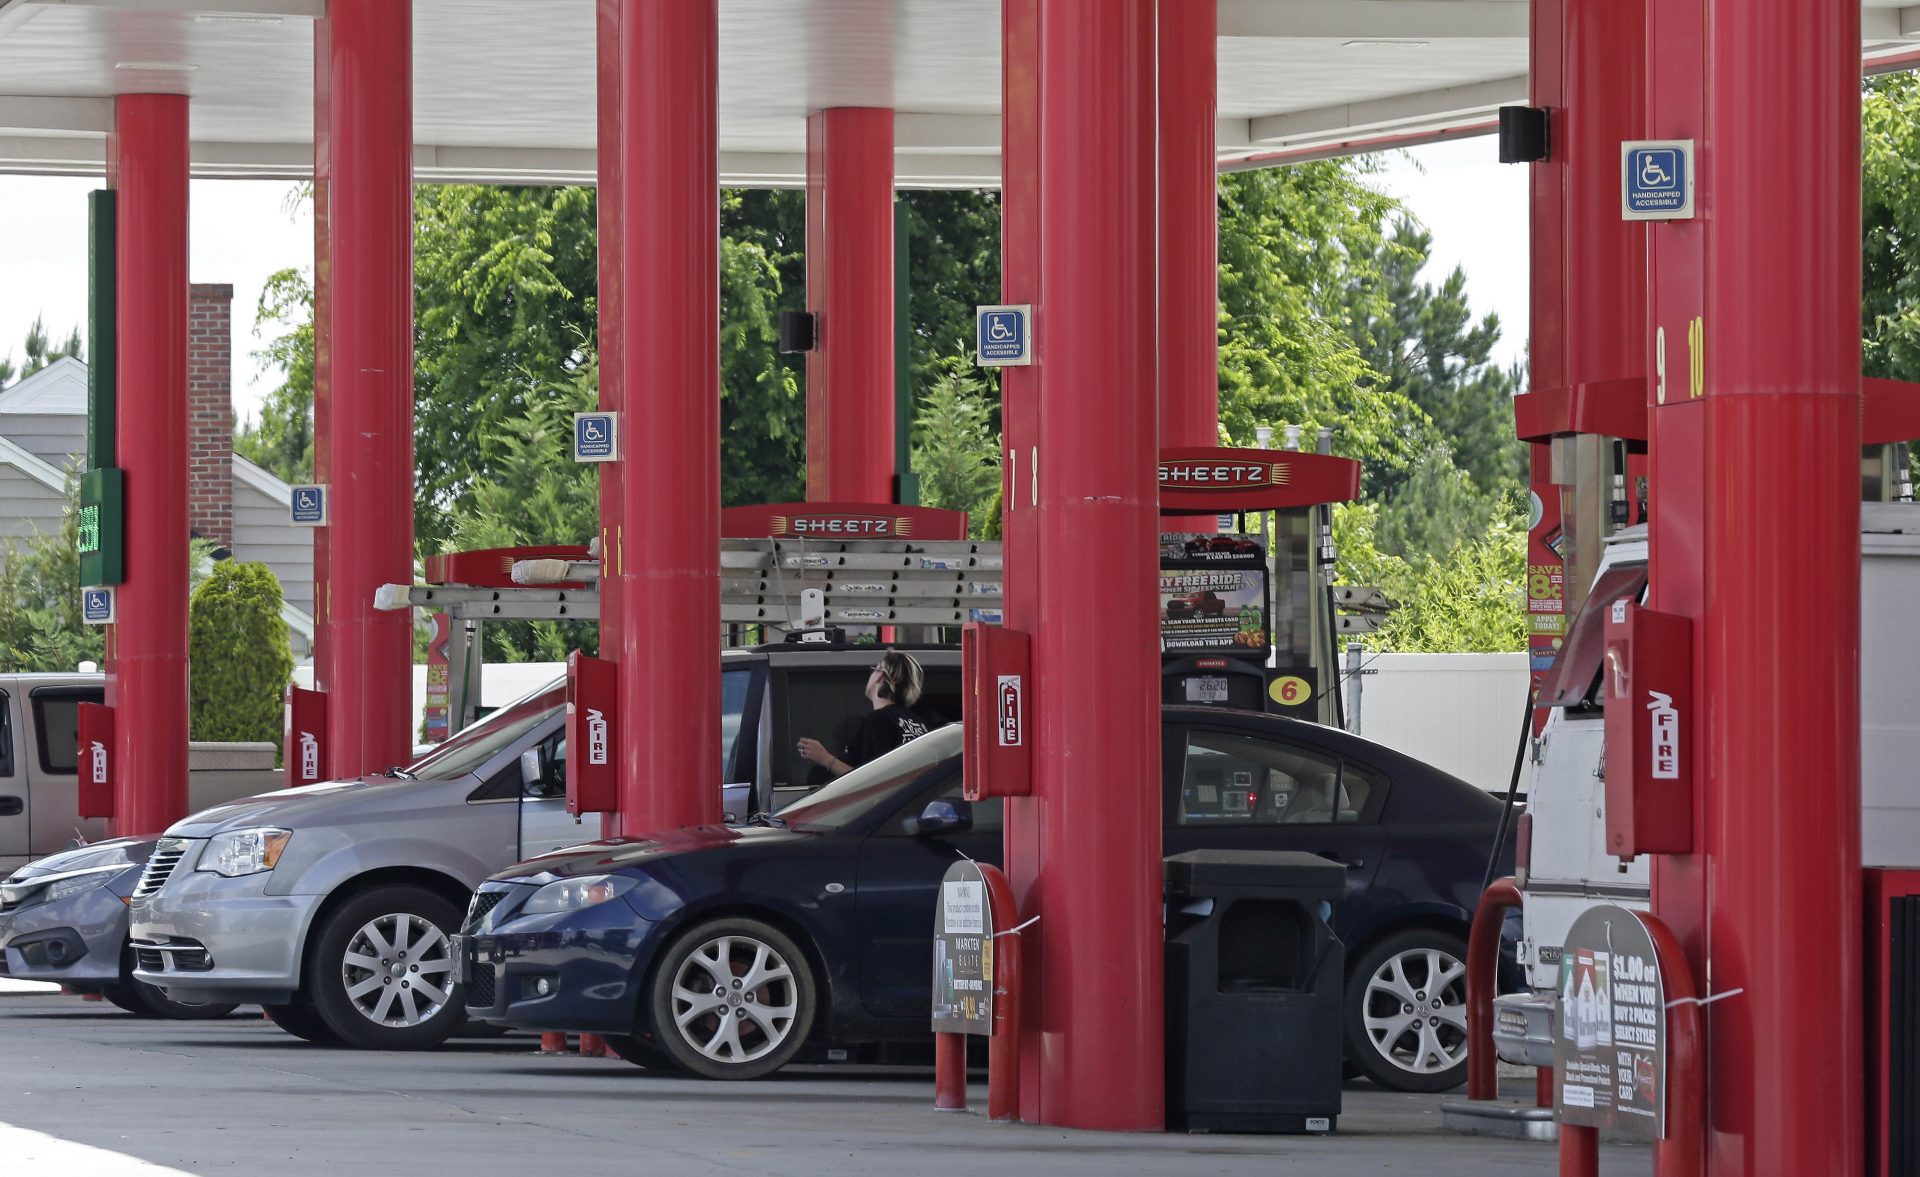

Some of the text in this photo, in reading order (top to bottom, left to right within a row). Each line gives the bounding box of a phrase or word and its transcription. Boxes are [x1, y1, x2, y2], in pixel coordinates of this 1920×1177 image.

[1632, 191, 1681, 199] HANDICAPPED
[1635, 199, 1678, 207] ACCESSIBLE
[1656, 316, 1703, 405] 9 10
[1032, 445, 1038, 507] 8
[1159, 466, 1264, 481] SHEETZ
[794, 519, 888, 532] SHEETZ
[603, 527, 608, 578] 5
[1529, 565, 1562, 575] SAVE
[1534, 622, 1560, 630] TODAY!
[1536, 615, 1557, 623] APPLY
[1166, 640, 1204, 648] DOWNLOAD
[1219, 638, 1234, 646] APP
[1281, 680, 1298, 701] 6
[1006, 693, 1016, 740] FIRE
[593, 723, 603, 760] FIRE
[1658, 714, 1672, 772] FIRE
[96, 752, 104, 779] FIRE
[306, 743, 315, 775] FIRE
[955, 938, 980, 950] MARKTEN
[959, 954, 979, 967] ELITE
[1613, 954, 1655, 983] $1.00 off
[1613, 983, 1656, 1005] WHEN YOU
[1614, 1005, 1656, 1026] BUY 2 PACKS
[1614, 1024, 1635, 1042] SELECT
[1636, 1027, 1656, 1045] STYLES
[1617, 1051, 1632, 1067] WITH
[1617, 1068, 1633, 1083] YOUR
[1618, 1084, 1633, 1101] CARD
